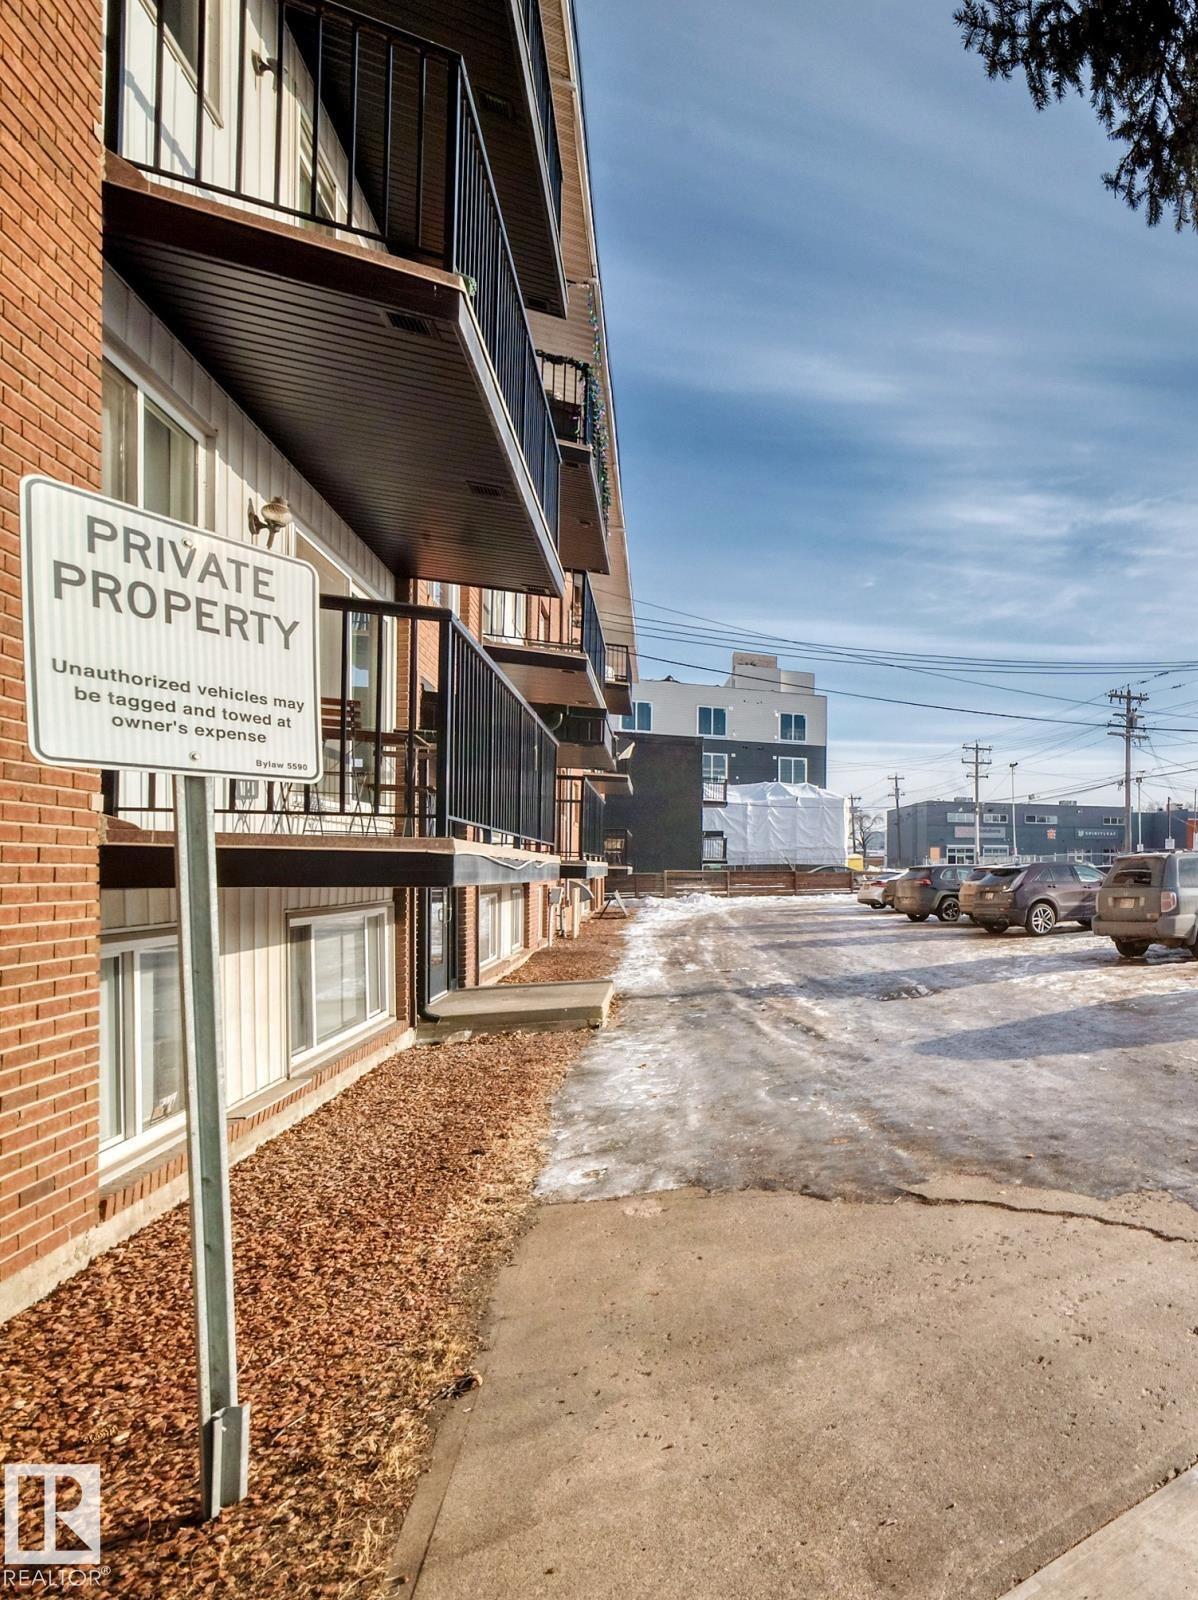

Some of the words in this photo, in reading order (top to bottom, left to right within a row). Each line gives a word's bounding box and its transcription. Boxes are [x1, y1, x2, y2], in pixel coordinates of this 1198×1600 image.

[86, 515, 276, 602] PRIVATE
[53, 560, 300, 650] PROPERTY
[52, 658, 190, 693] Unauthorized
[197, 684, 268, 706] vehicles
[273, 697, 305, 714] may
[74, 686, 101, 703] be
[108, 691, 176, 713] tagged
[183, 704, 216, 719] and
[222, 708, 272, 727] towed
[277, 716, 292, 729] at
[112, 715, 188, 735] owner's
[194, 725, 267, 744] expense
[255, 759, 284, 769] Bylaw
